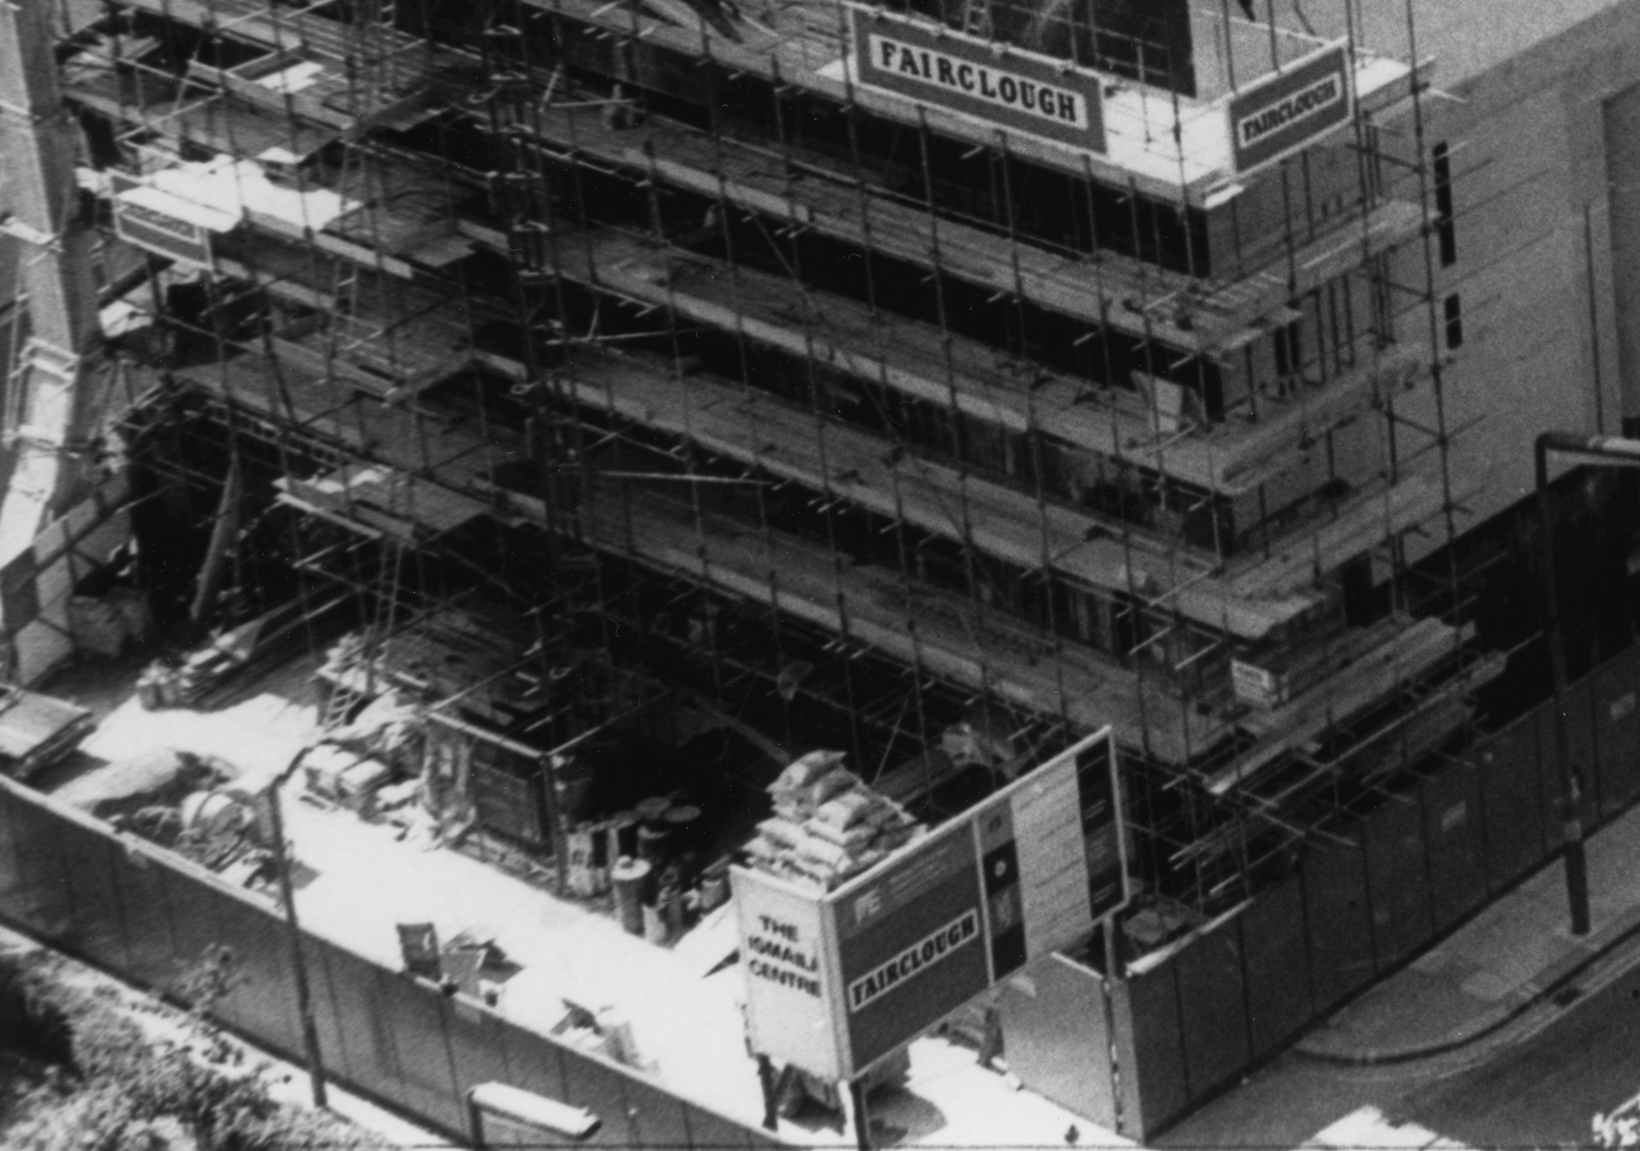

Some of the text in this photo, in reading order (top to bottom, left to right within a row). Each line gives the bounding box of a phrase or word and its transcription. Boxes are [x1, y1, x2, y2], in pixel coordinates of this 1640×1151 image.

[880, 40, 1077, 123] FAIRCLOUGH
[1242, 78, 1336, 141] FAIRCLOUGH
[758, 914, 800, 943] THE
[852, 913, 976, 1006] FAIRCLOUGH
[748, 958, 822, 999] CENTRE
